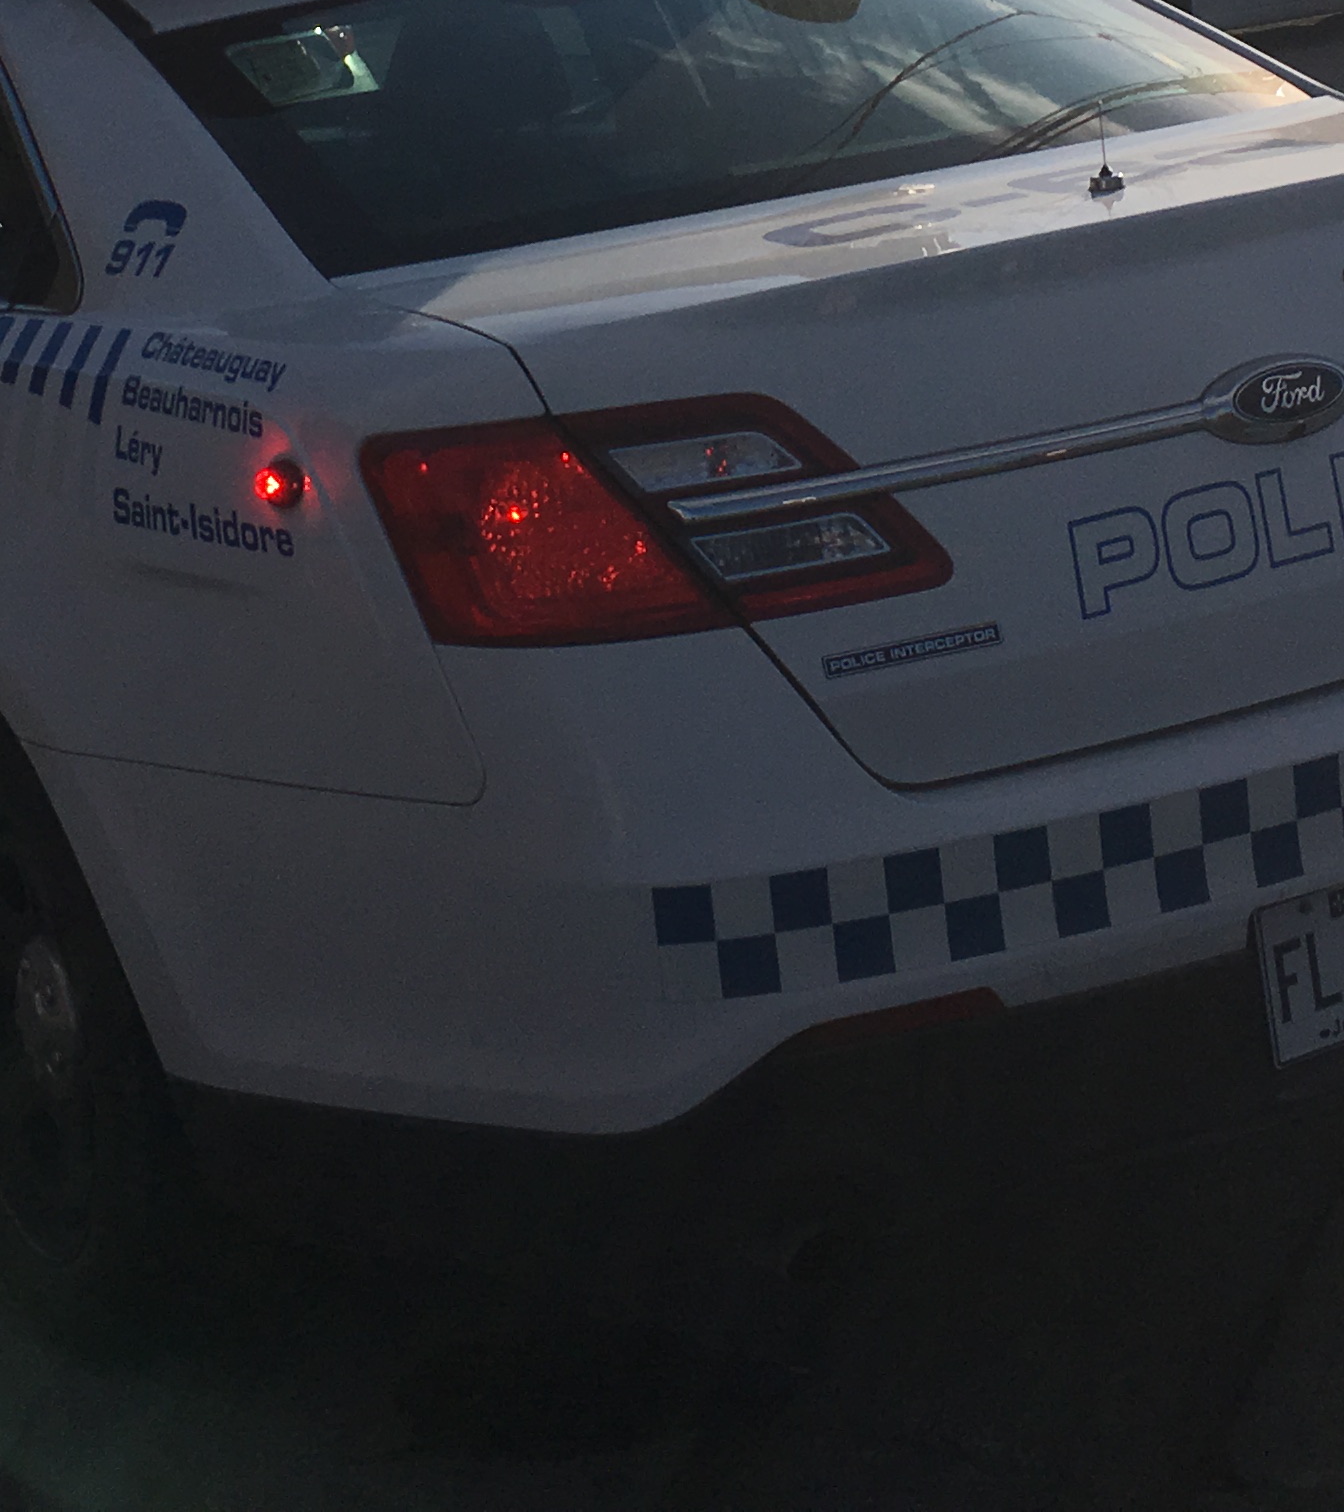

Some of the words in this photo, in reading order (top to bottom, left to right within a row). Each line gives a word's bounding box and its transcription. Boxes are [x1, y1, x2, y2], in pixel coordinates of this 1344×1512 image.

[105, 240, 176, 279] 911
[121, 375, 264, 439] Beauharnois
[1260, 370, 1325, 414] Ford
[114, 425, 164, 476] Léry
[112, 487, 296, 558] Saint-Isidore
[829, 650, 886, 672] POLICE
[889, 627, 996, 660] INTERCEPTOR
